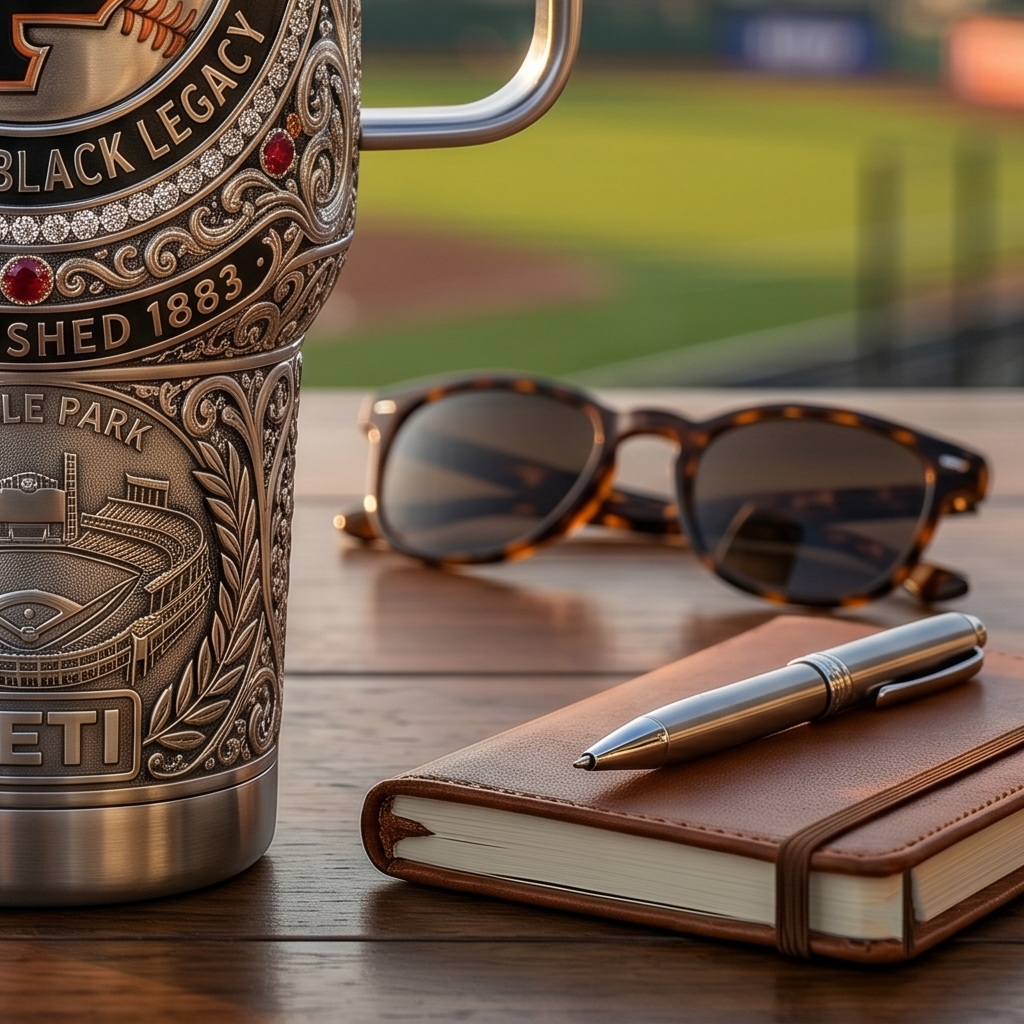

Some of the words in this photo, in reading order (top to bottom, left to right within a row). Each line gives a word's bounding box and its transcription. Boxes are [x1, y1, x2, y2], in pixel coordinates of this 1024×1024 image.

[136, 10, 265, 160] LEGACY
[148, 264, 244, 337] 1883
[58, 396, 154, 452] PARK
